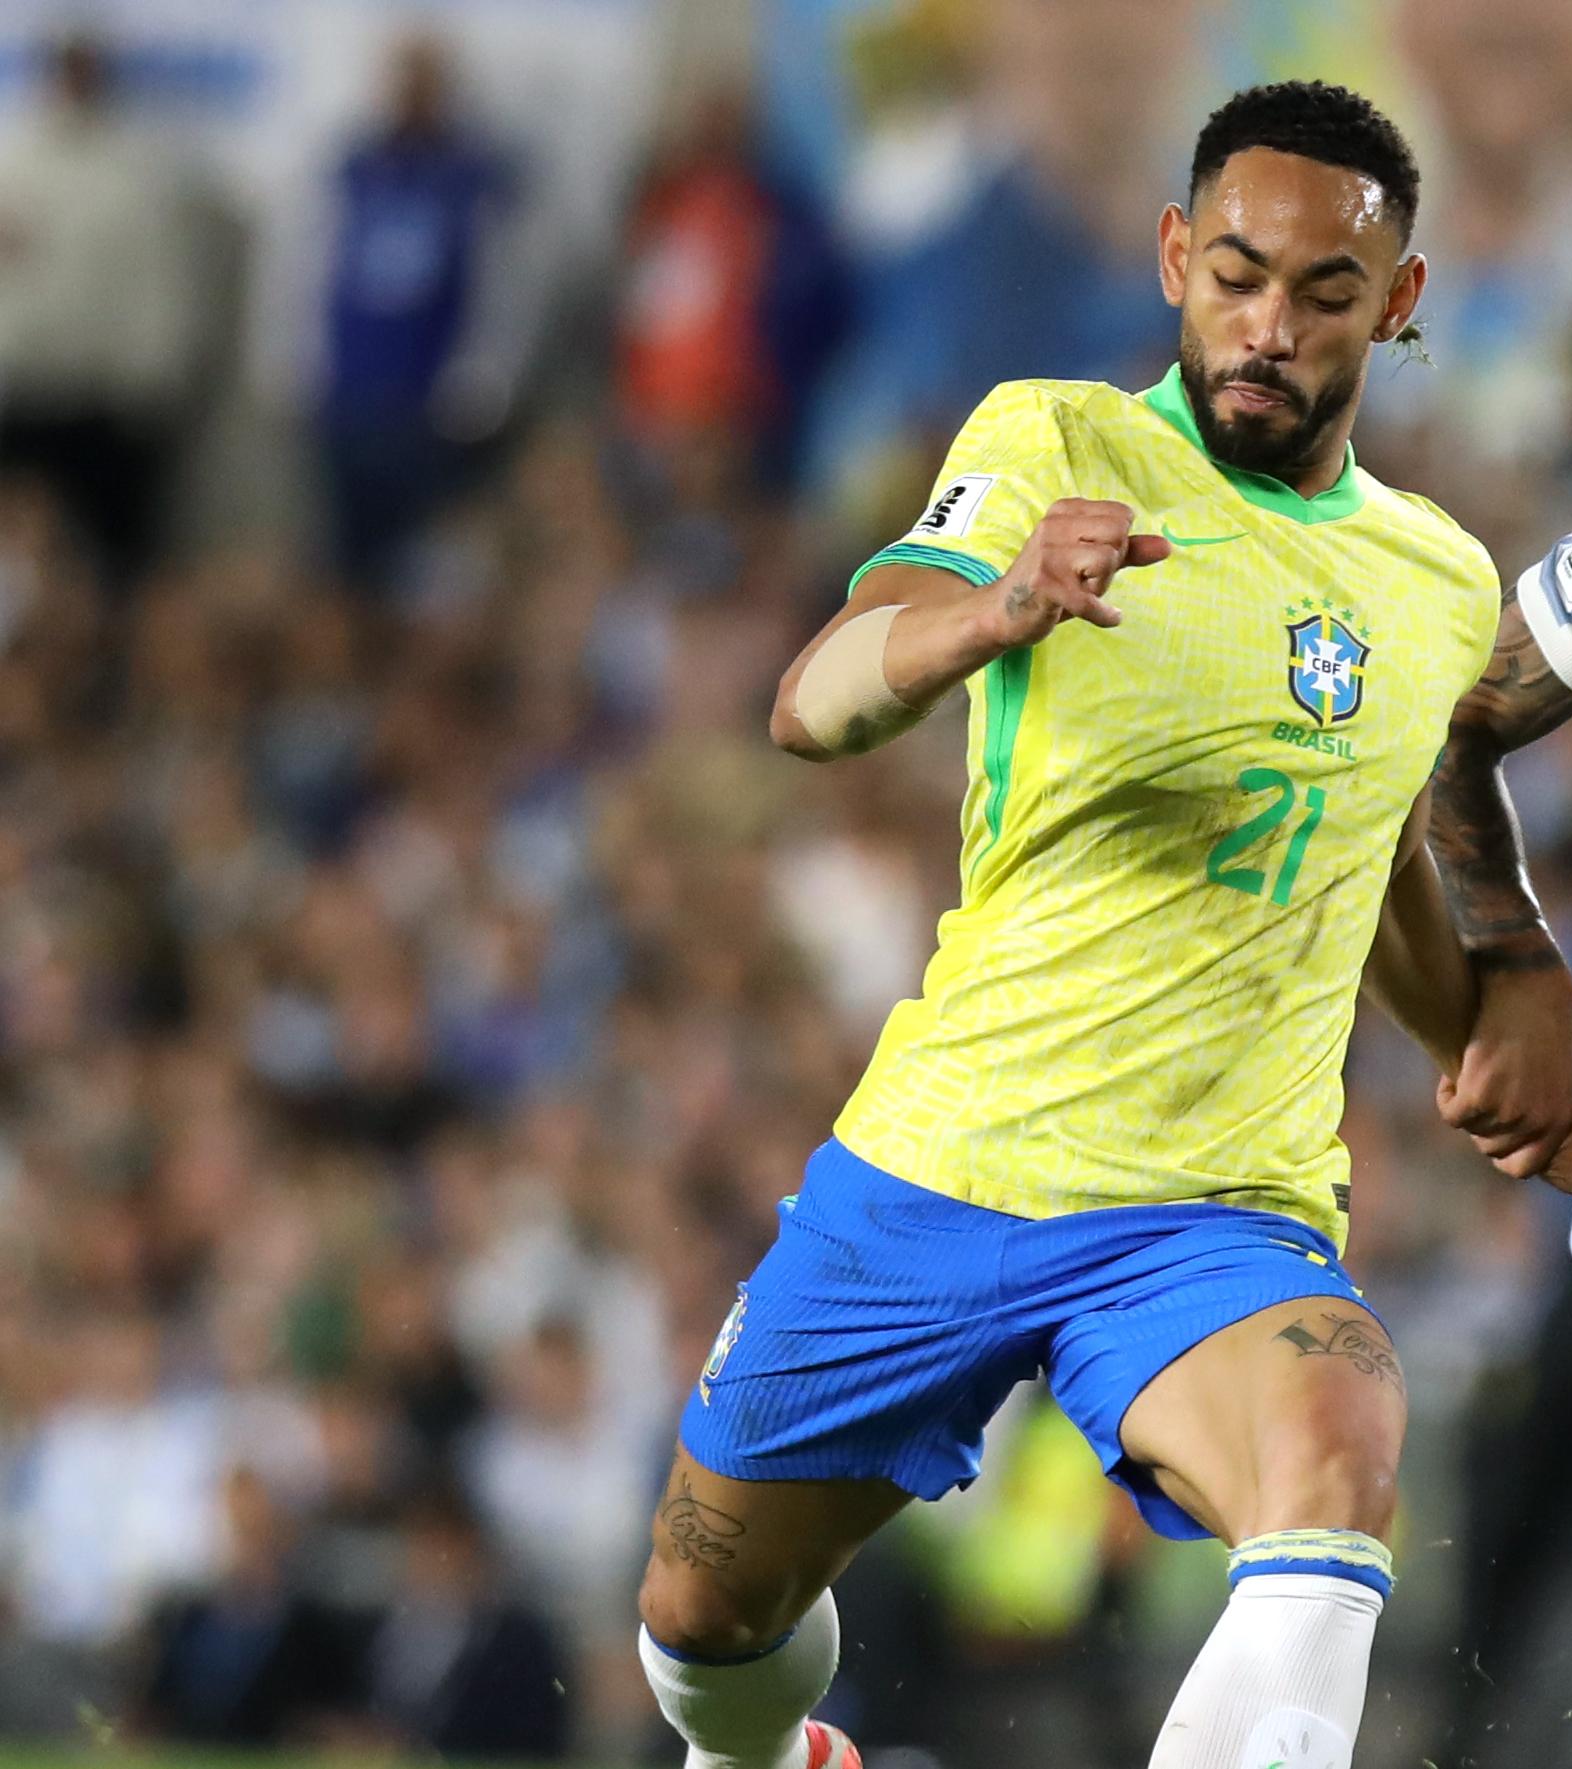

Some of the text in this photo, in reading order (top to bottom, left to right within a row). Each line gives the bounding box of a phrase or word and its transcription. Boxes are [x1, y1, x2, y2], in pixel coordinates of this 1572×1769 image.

[1312, 657, 1342, 676] CBF
[1271, 721, 1358, 761] BRASIL
[1206, 767, 1328, 907] 21
